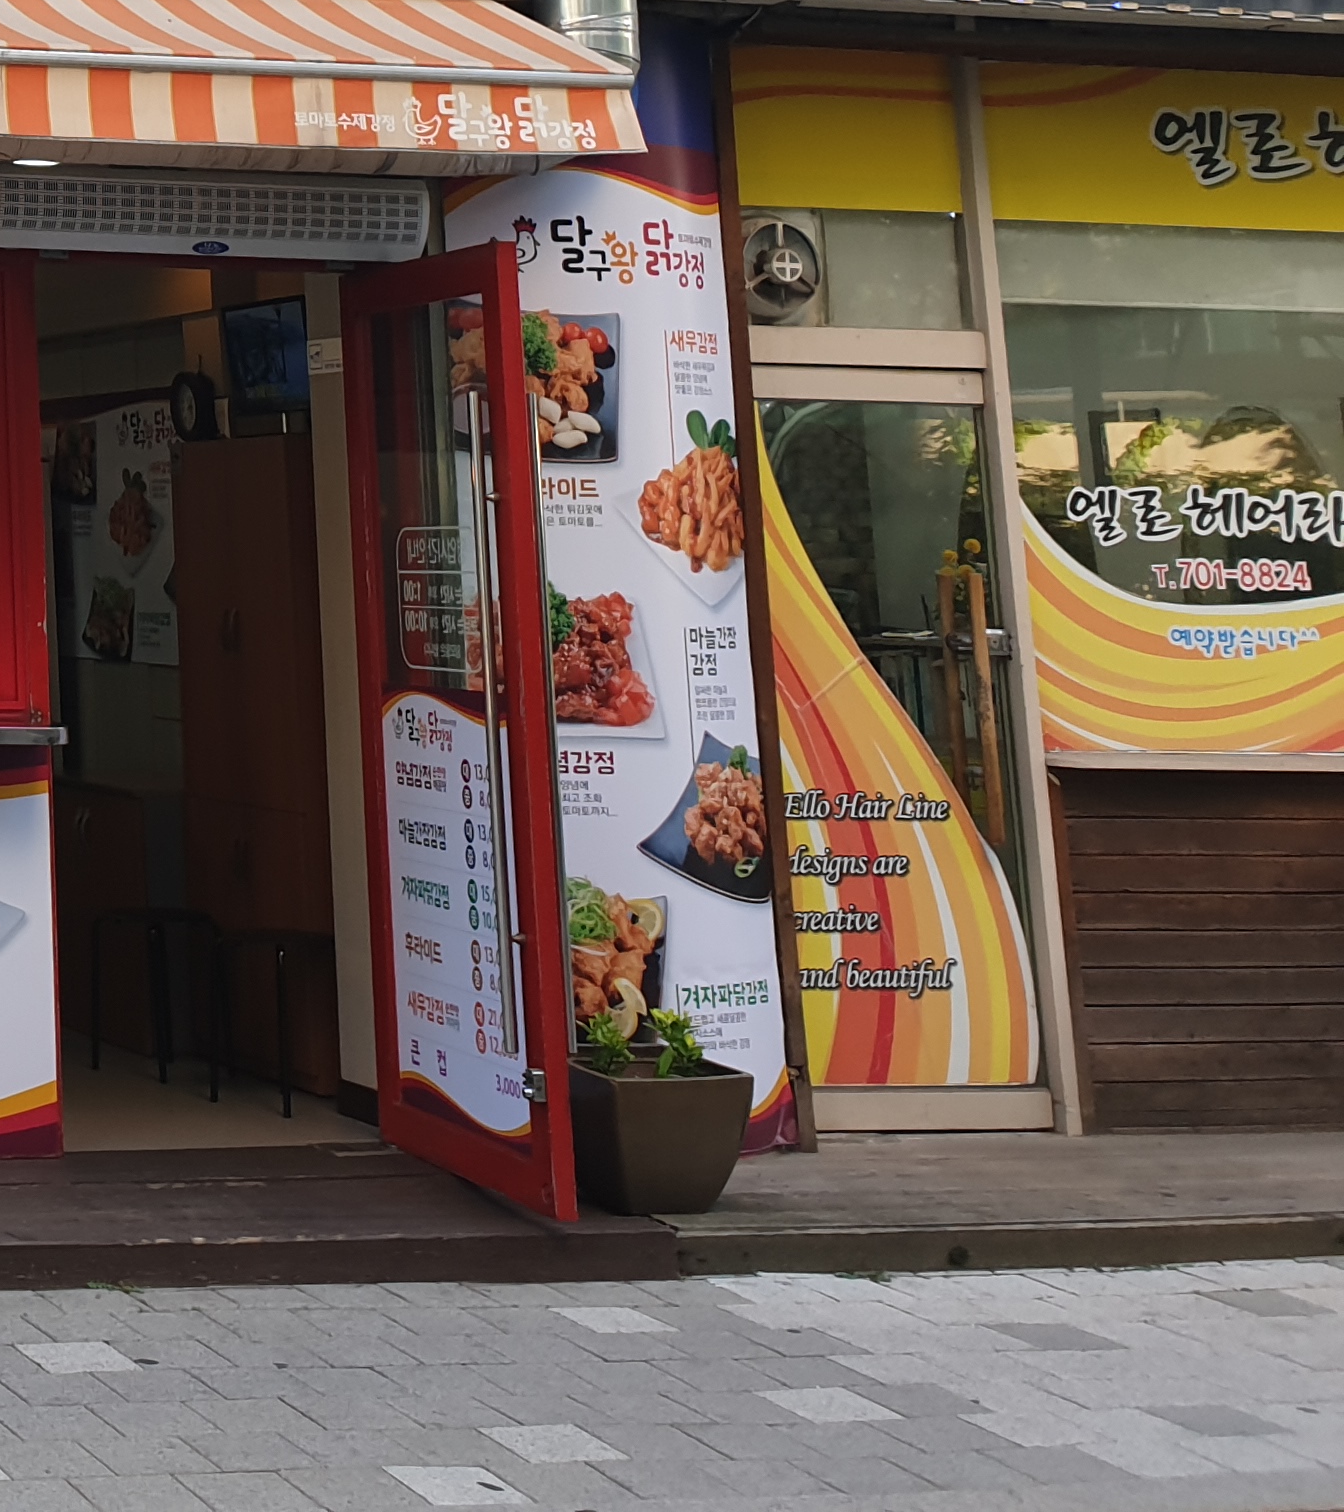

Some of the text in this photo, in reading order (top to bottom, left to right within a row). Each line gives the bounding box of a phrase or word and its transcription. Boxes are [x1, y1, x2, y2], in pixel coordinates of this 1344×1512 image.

[293, 90, 598, 150] 토마토수제강정 달구왕 닭강정
[549, 214, 706, 290] 달구왕 닭강정
[669, 329, 719, 356] 새우강정
[689, 626, 737, 650] 마늘간장
[689, 652, 718, 677] 강정
[783, 789, 951, 821] Ello Hair Line
[789, 845, 908, 884] designs are
[794, 904, 880, 931] creative
[404, 931, 443, 964] 후라이드
[846, 957, 958, 998] beautiful
[681, 978, 769, 1010] 겨자파닭강정
[495, 1073, 522, 1099] 3,000
